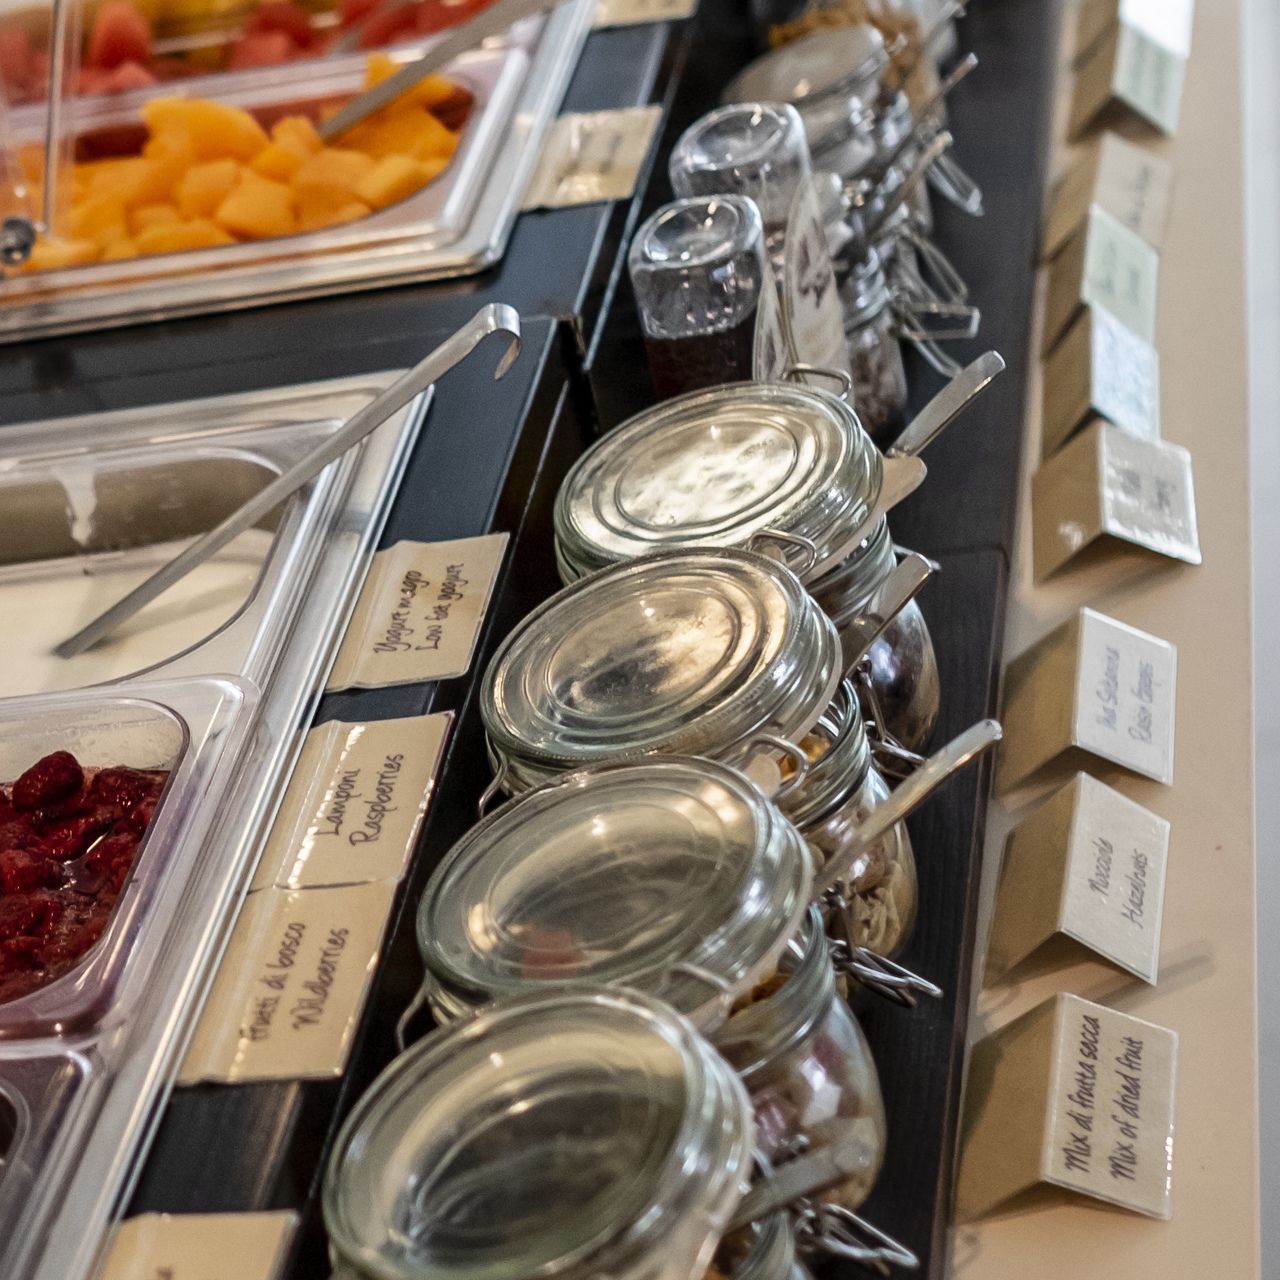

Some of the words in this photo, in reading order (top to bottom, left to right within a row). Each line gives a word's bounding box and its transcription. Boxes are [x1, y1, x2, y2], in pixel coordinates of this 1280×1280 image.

[317, 768, 361, 836] Lamponi
[349, 753, 404, 847] Raspberries
[267, 922, 306, 971] bosco
[1078, 1014, 1101, 1061] secca
[1114, 1035, 1144, 1072] fruit
[1066, 1060, 1097, 1110] frutta
[1111, 1069, 1142, 1119] dried
[1066, 1109, 1094, 1132] di
[1110, 1114, 1139, 1140] of
[1061, 1131, 1092, 1174] Mix
[1107, 1140, 1138, 1182] Mix
